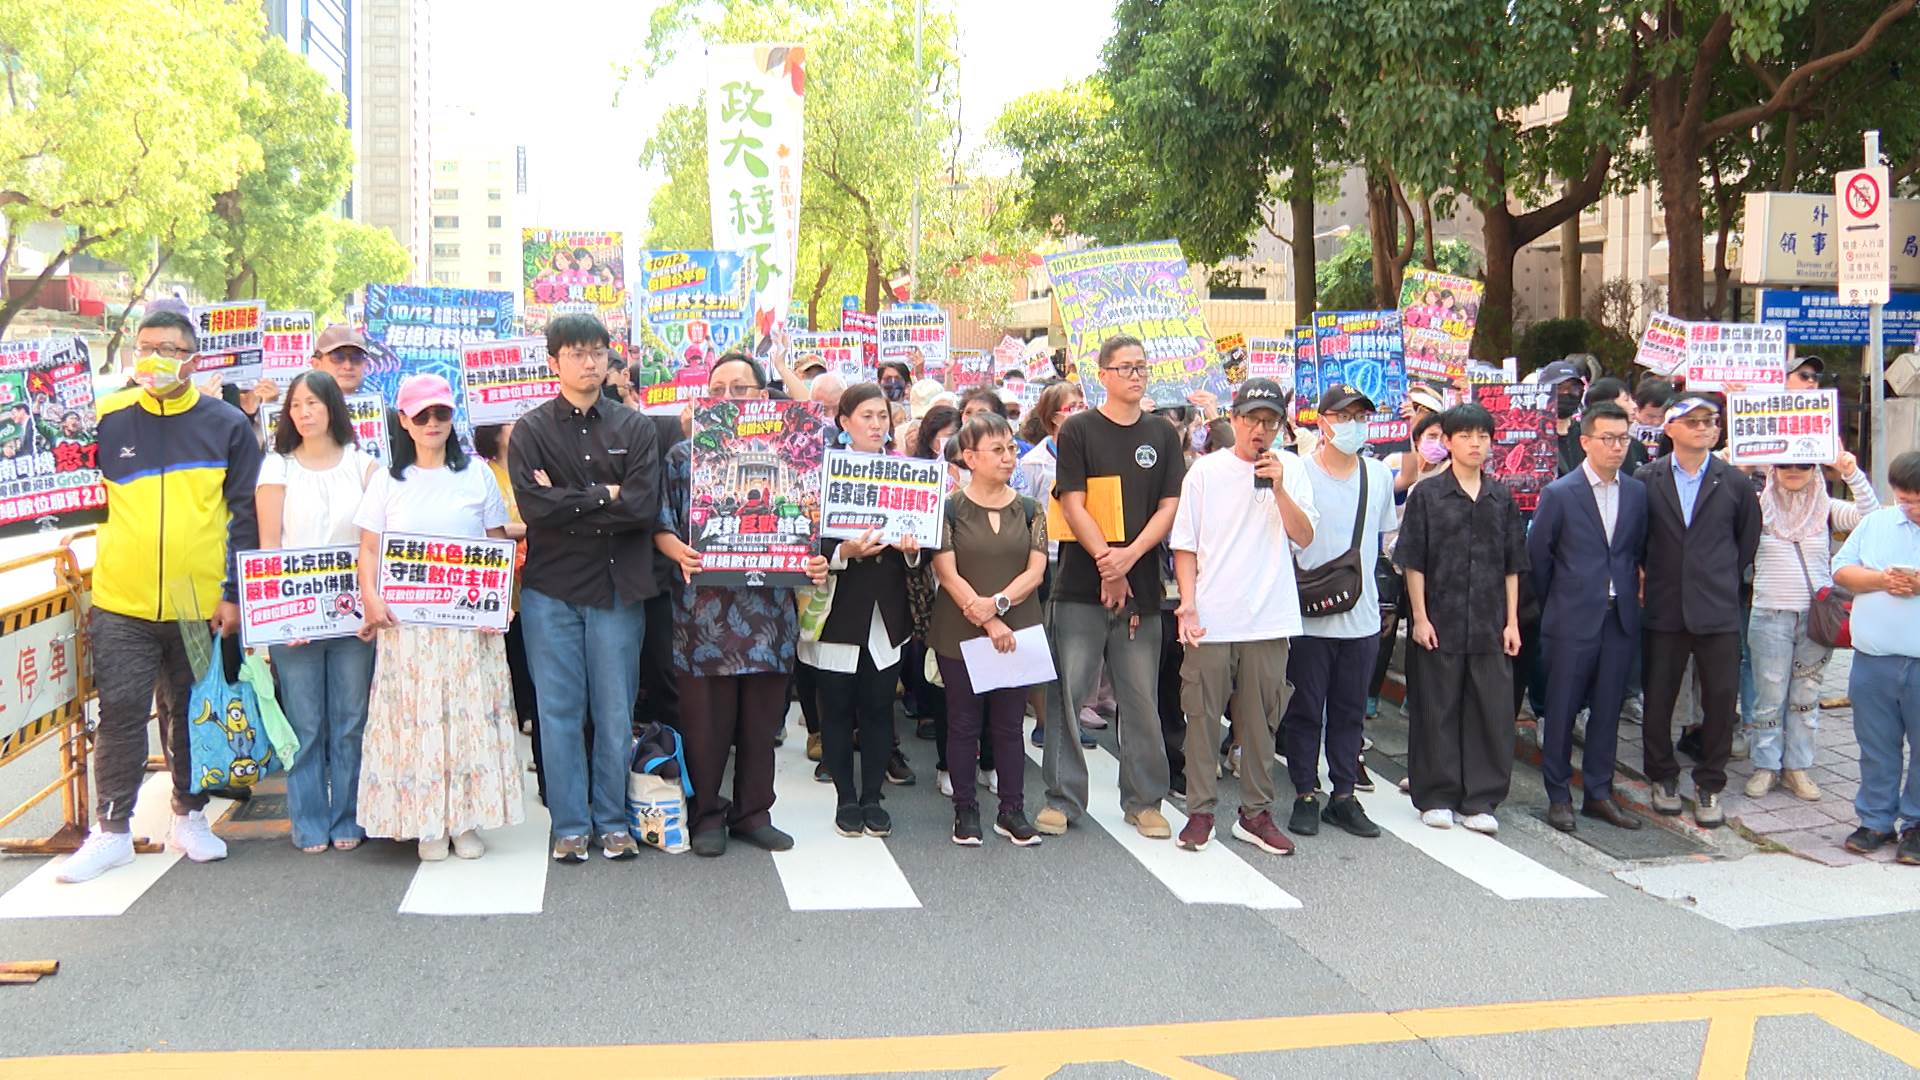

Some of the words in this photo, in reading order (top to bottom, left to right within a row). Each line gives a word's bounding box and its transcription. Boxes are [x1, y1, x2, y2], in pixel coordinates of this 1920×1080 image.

[720, 81, 782, 293] 政大種子
[650, 255, 683, 269] 10/12
[1797, 269, 1827, 279] Ministry
[391, 304, 432, 320] 10/12
[744, 401, 777, 414] 10/12
[1480, 395, 1551, 411] 包圍公平會
[1734, 393, 1830, 415] Uber持股Grab
[1368, 424, 1408, 440] 服貿2.0
[1735, 415, 1832, 436] 店家還有真選擇嗎?
[830, 458, 939, 484] Uber持股Grab
[829, 481, 939, 513] 店家還有真選擇嗎?
[385, 539, 510, 567] 反對紅色技術,
[389, 561, 508, 589] 守護數位主權!
[385, 589, 452, 603] 反數位服貿2.0
